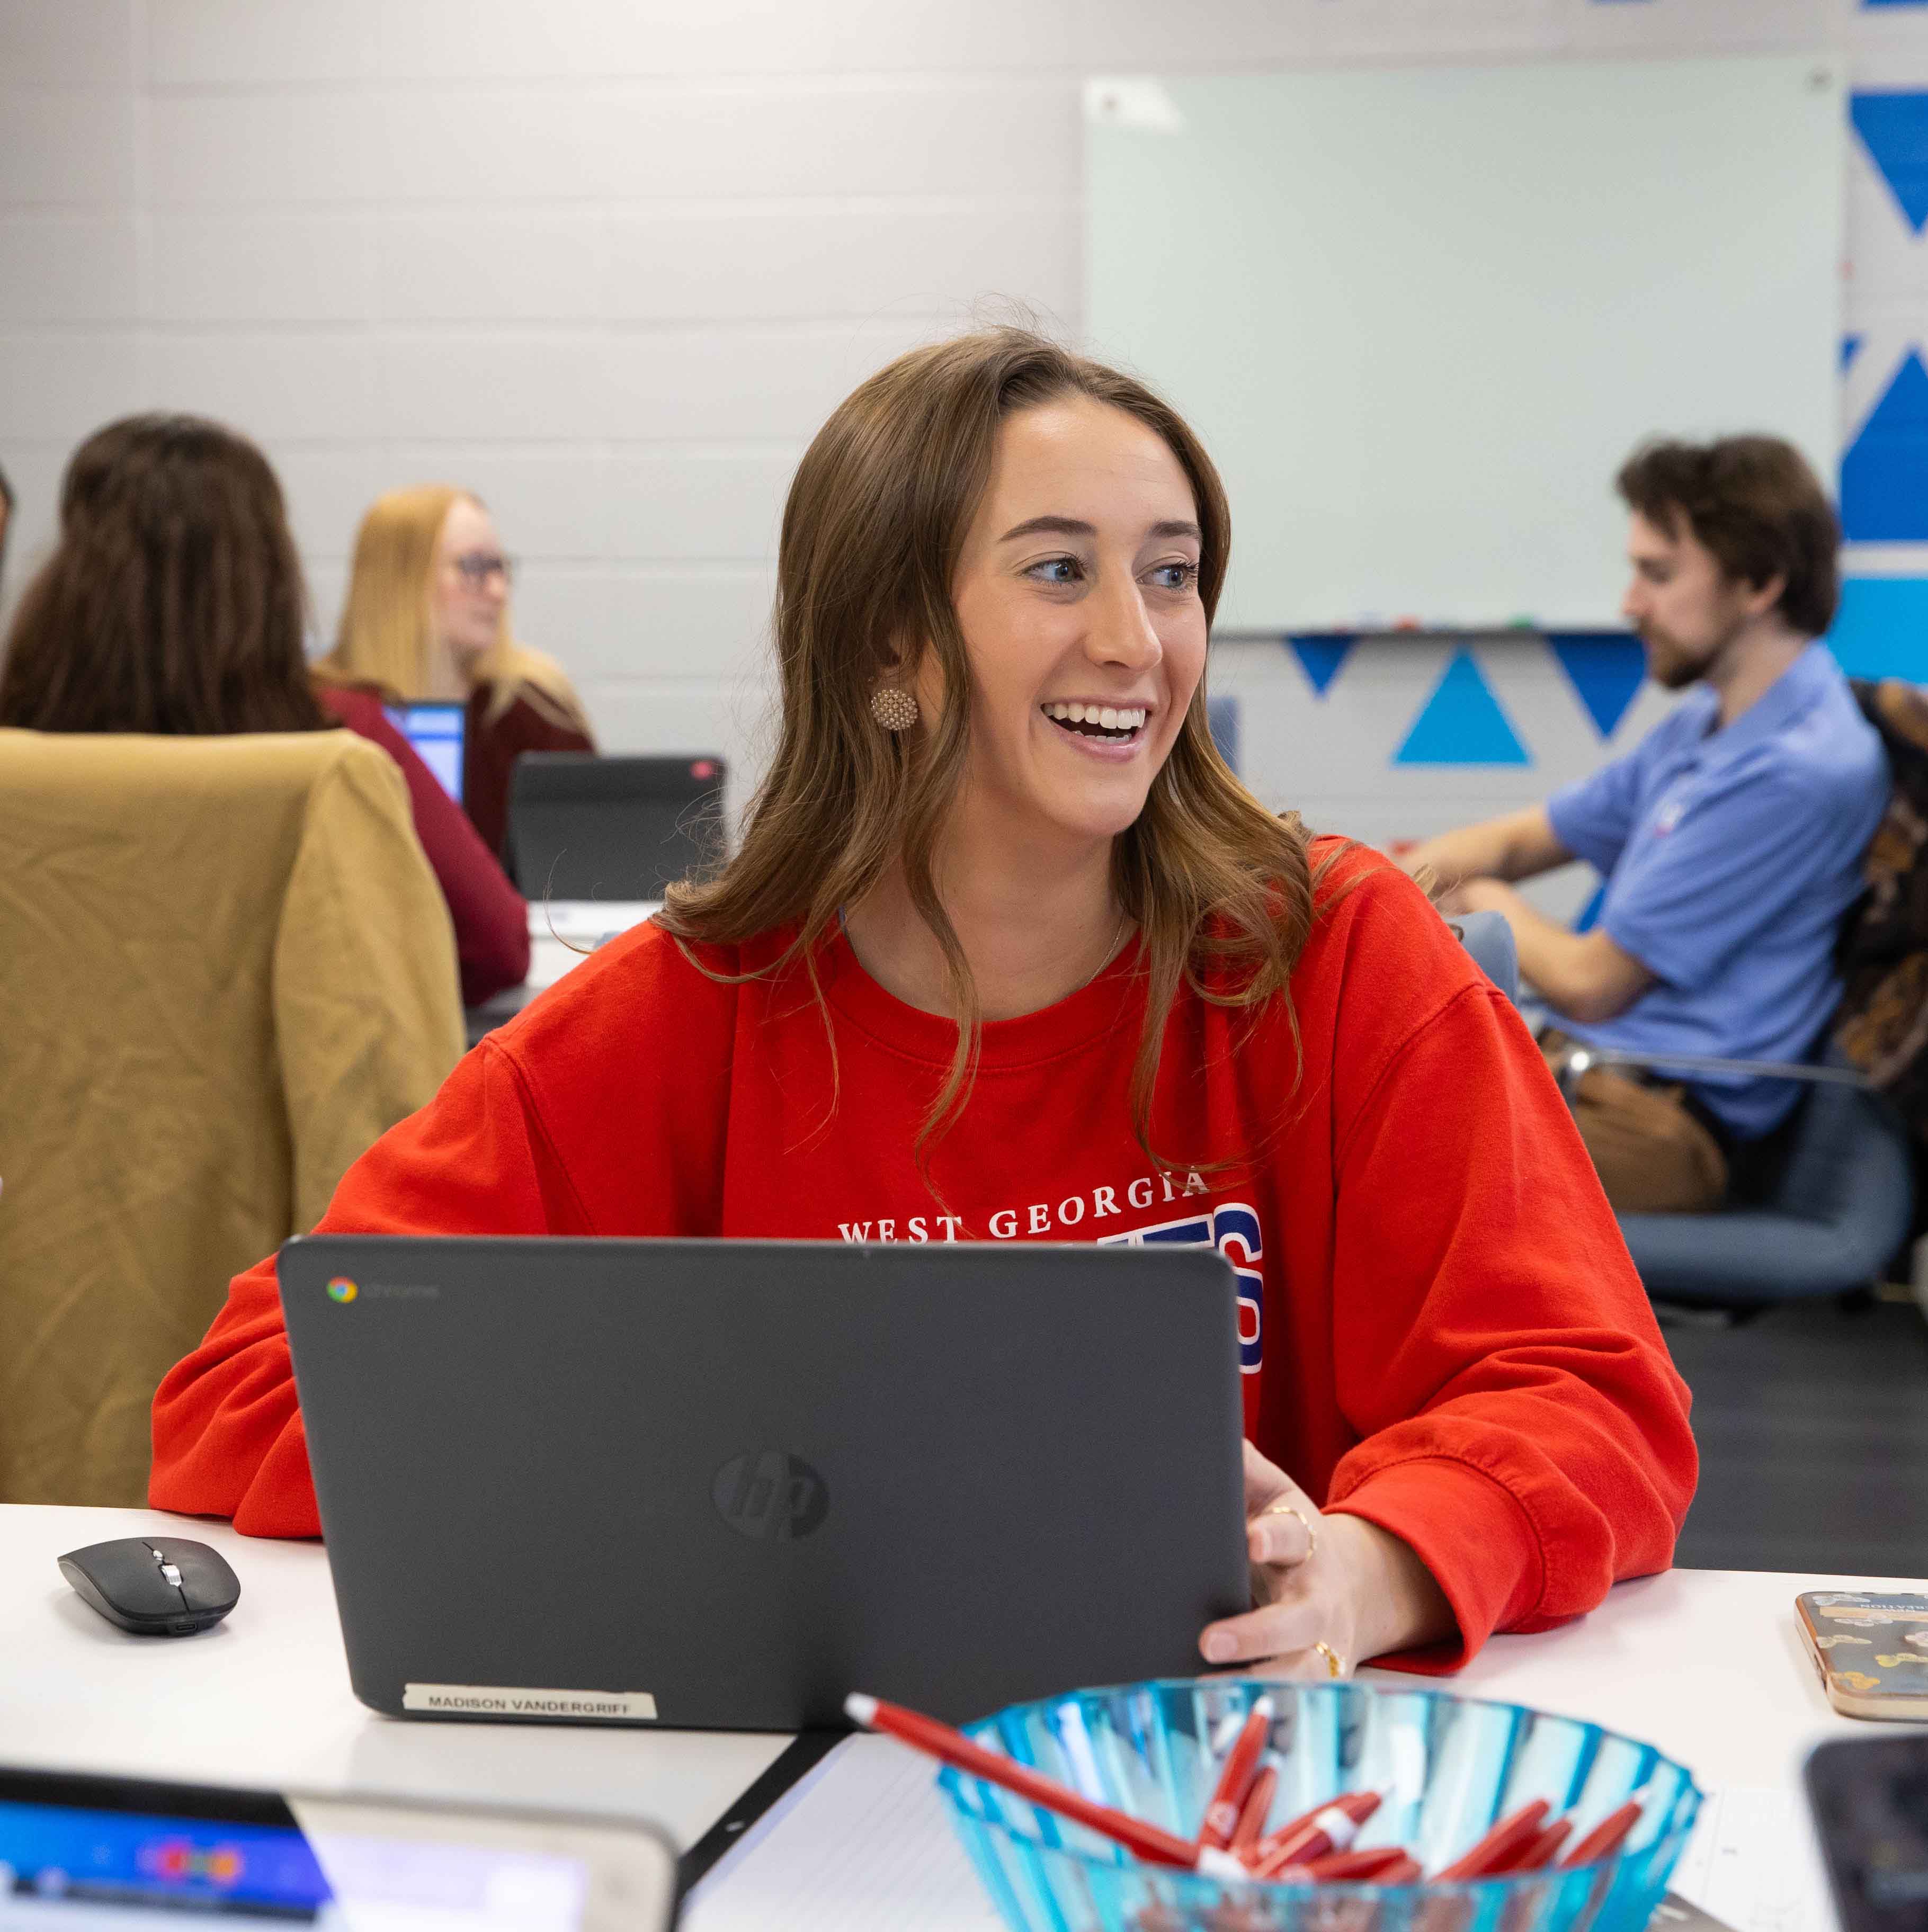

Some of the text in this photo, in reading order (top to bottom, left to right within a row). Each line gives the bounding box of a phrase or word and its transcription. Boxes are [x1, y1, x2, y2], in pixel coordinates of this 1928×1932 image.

[837, 1166, 1212, 1245] WEST GEORGIA
[726, 1453, 816, 1539] hp
[429, 1696, 631, 1714] MADISON VANDERGRIFF
